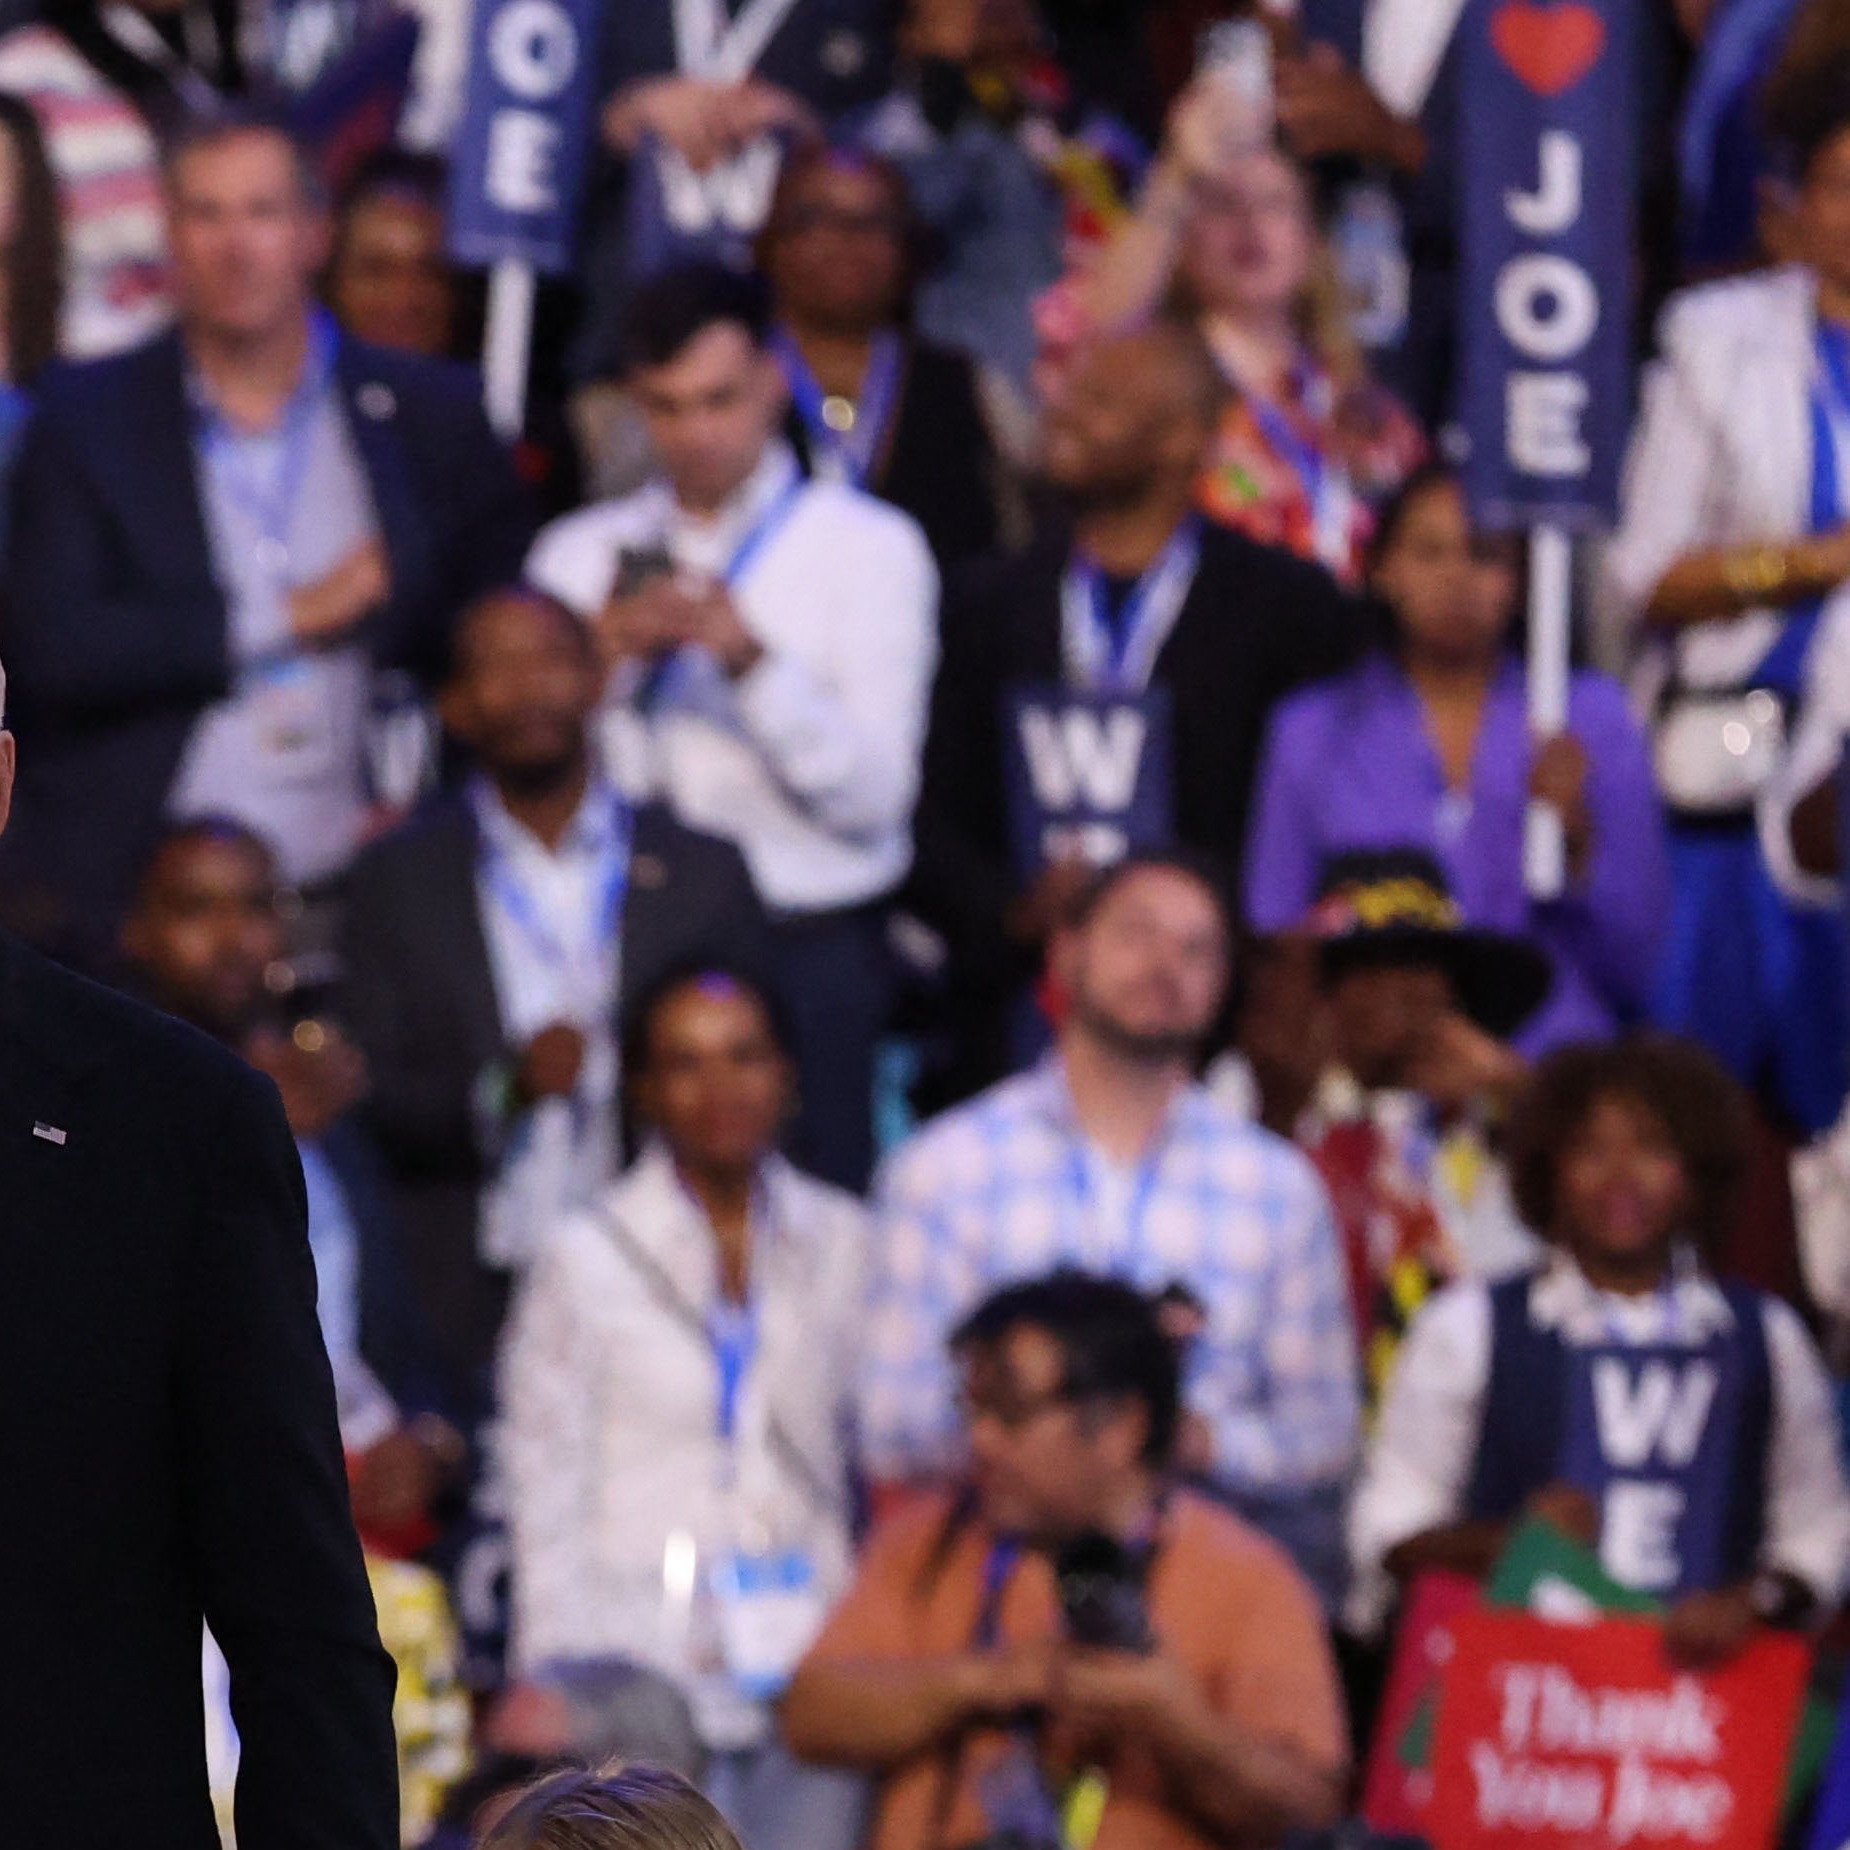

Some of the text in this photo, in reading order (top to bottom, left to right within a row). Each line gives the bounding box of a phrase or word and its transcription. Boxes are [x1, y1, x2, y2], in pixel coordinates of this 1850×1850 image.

[1494, 129, 1602, 480] JOE
[1590, 1353, 1722, 1592] WE
[1465, 1738, 1604, 1835] You
[1490, 1660, 1728, 1765] Thank
